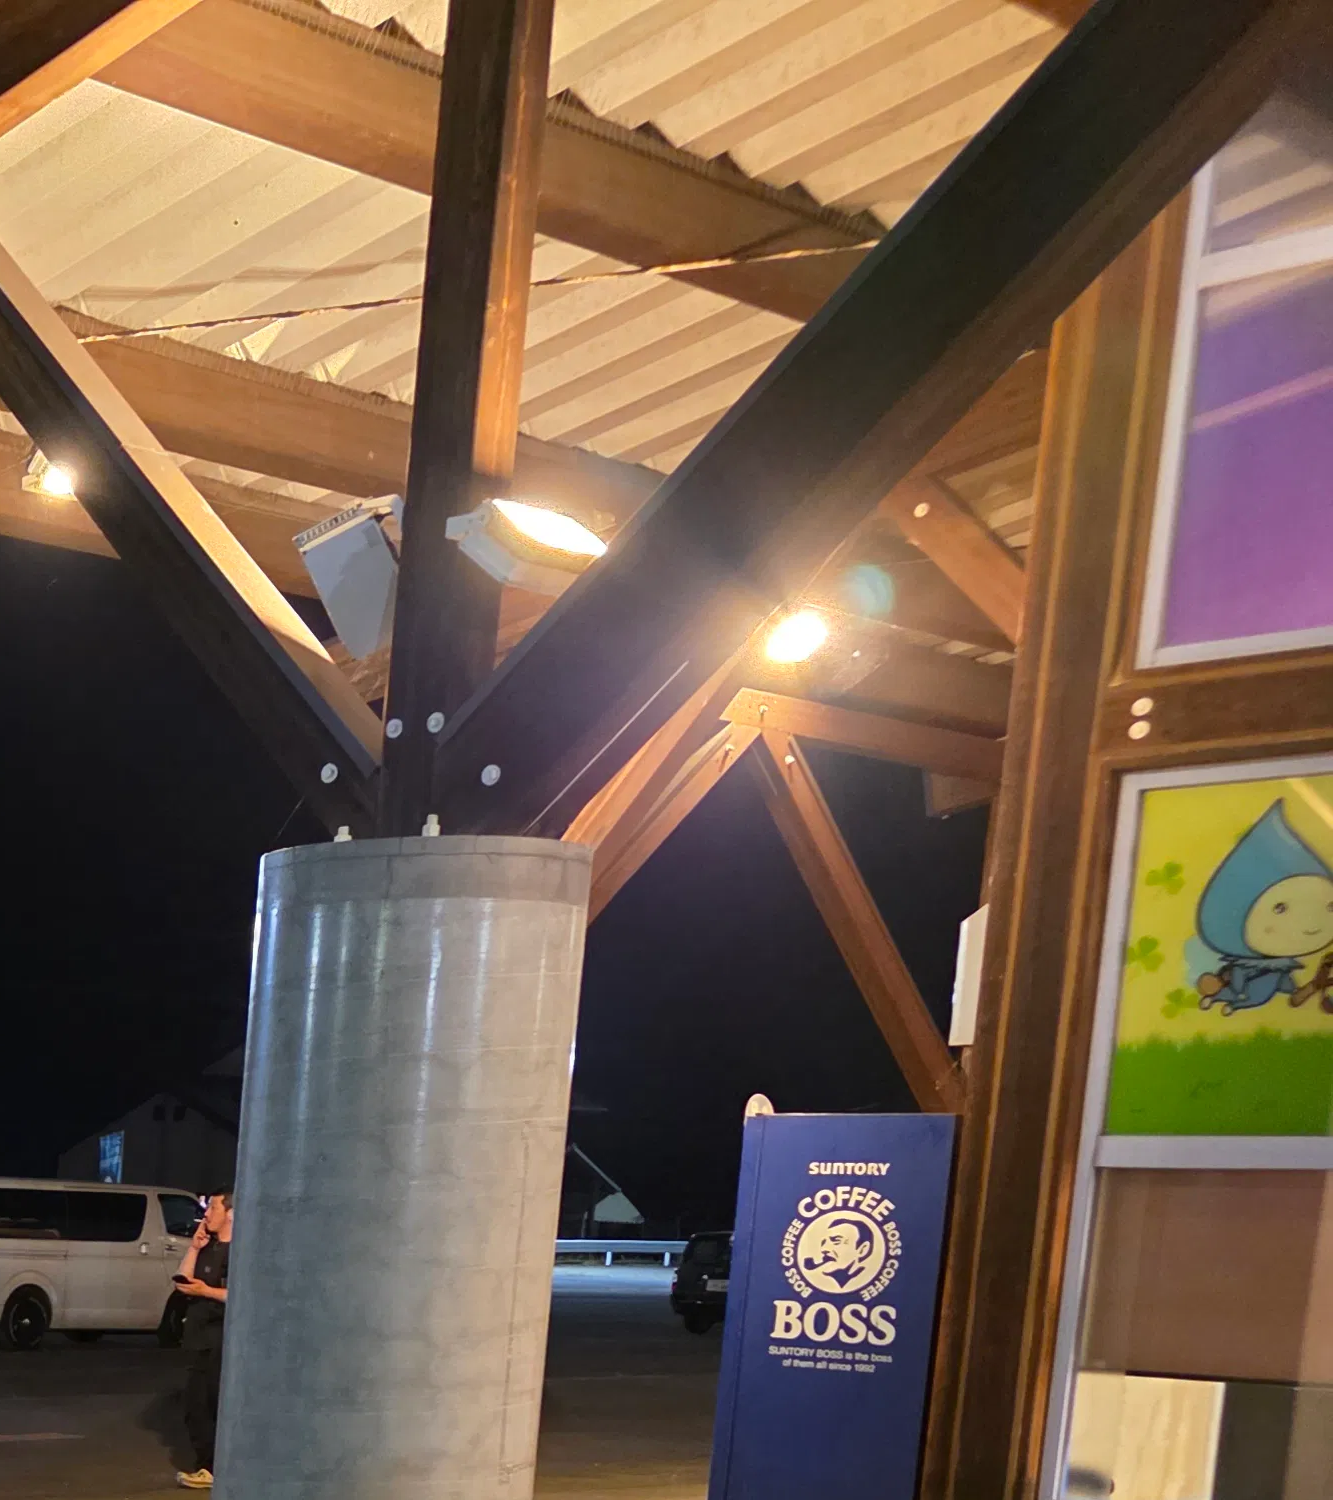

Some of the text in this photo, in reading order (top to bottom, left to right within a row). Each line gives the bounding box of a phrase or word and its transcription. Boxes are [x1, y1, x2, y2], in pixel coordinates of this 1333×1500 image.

[798, 1186, 895, 1221] COFFEE
[781, 1219, 813, 1298] BOSS COFFEE
[861, 1221, 902, 1301] BOSS COFFEE
[770, 1300, 896, 1346] BOSS
[768, 1346, 893, 1363] SUNTORY BOSS is the boss
[782, 1359, 791, 1367] of
[793, 1359, 814, 1369] them
[816, 1361, 827, 1369] all
[829, 1361, 851, 1371] since
